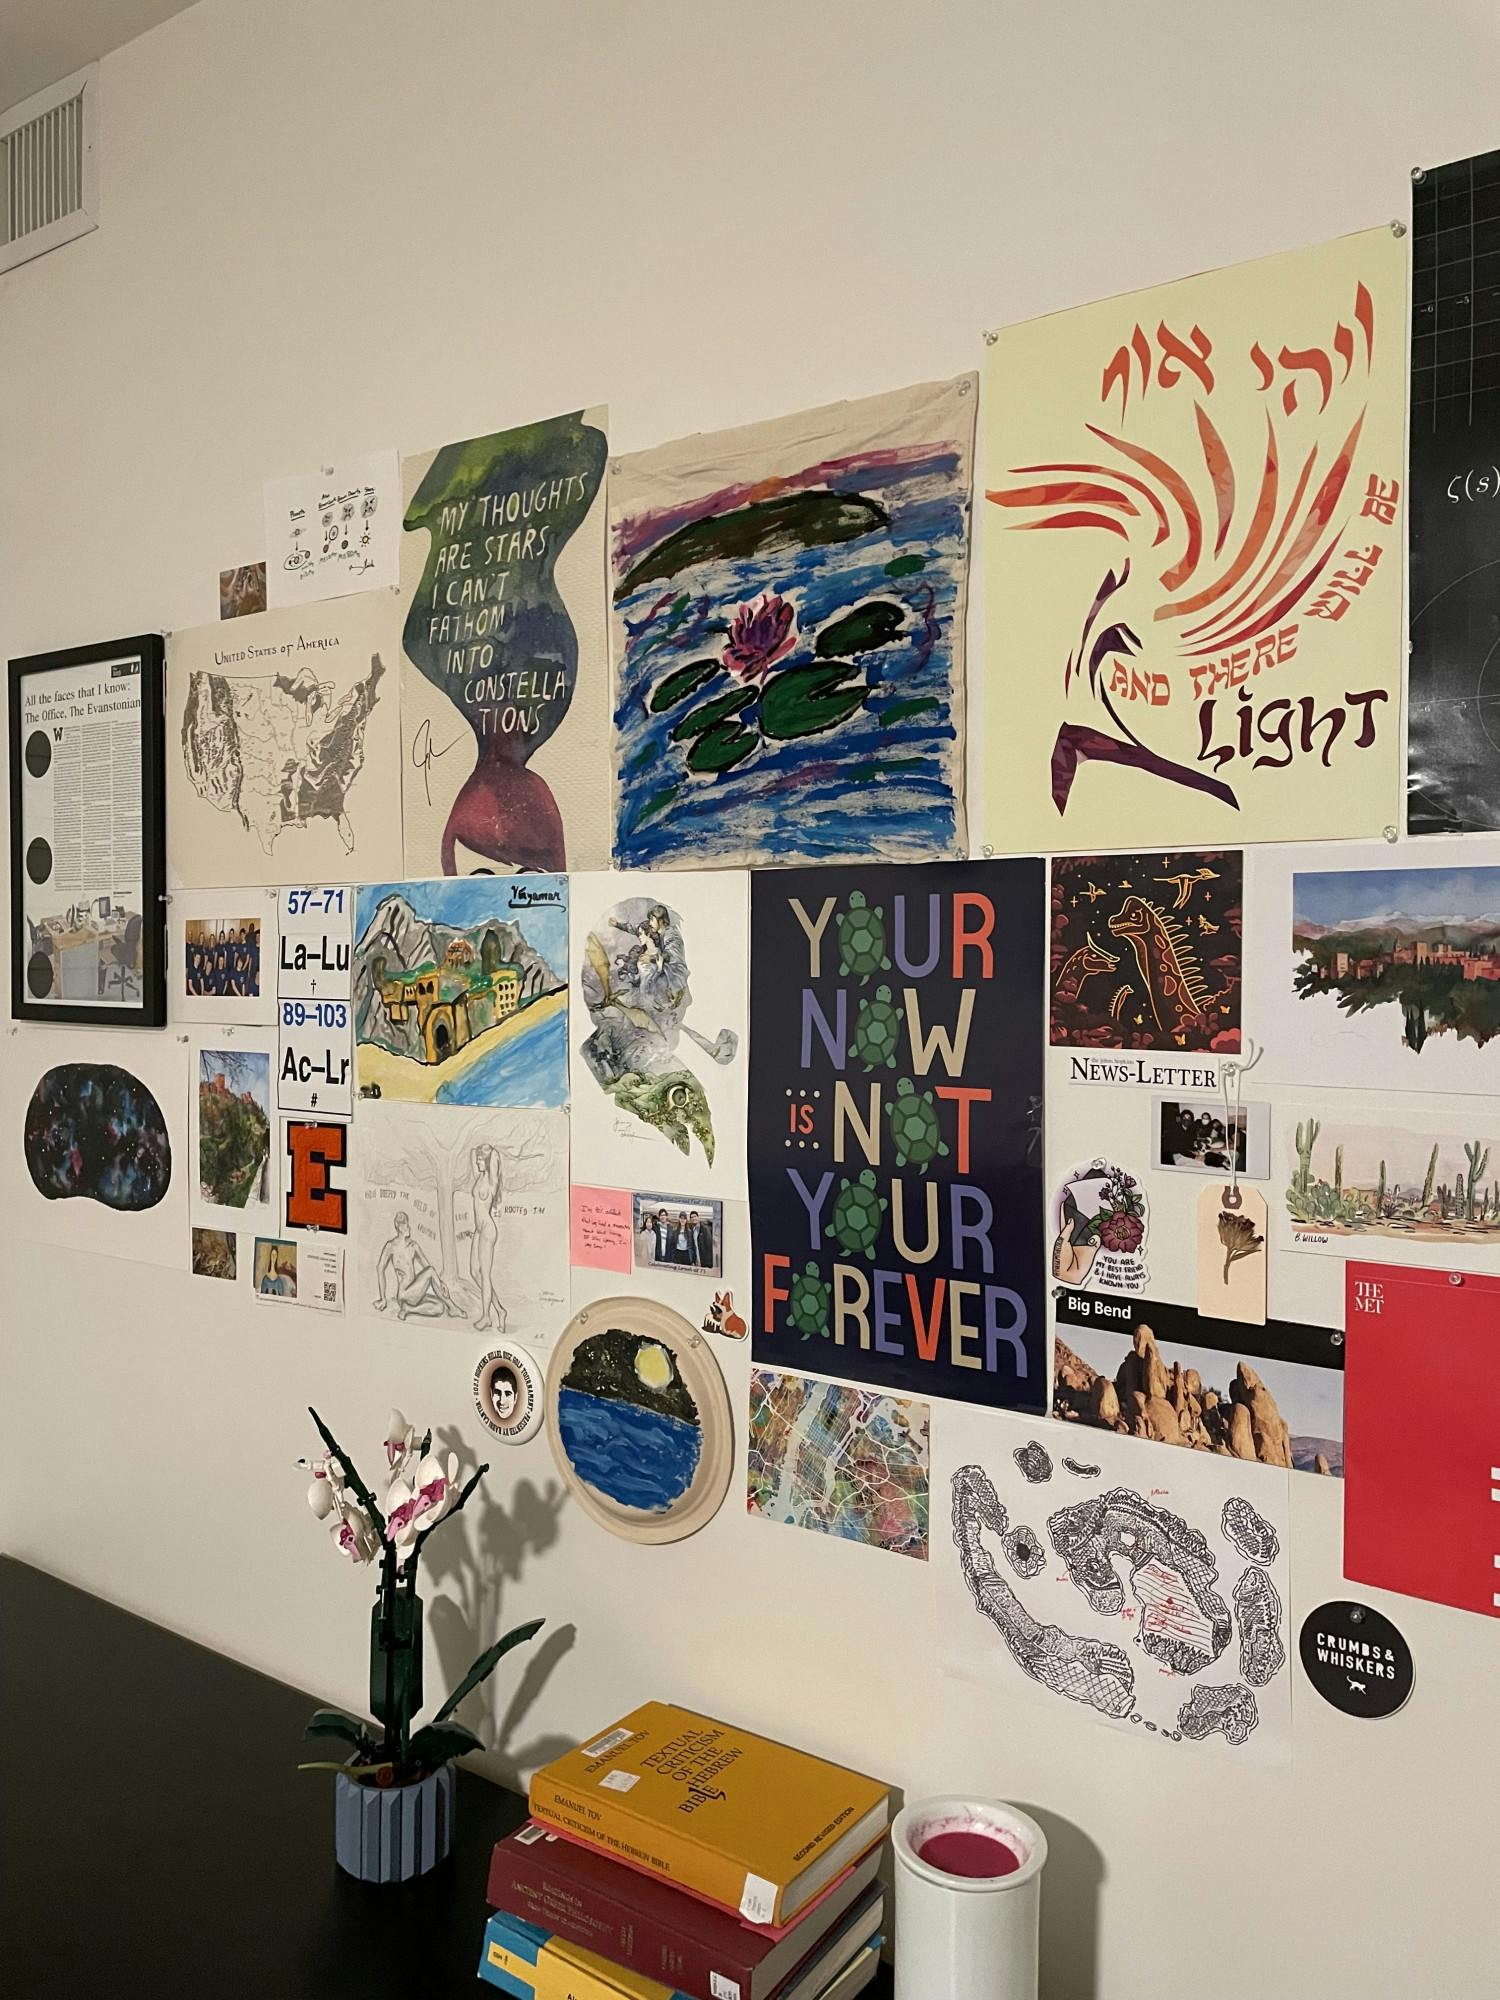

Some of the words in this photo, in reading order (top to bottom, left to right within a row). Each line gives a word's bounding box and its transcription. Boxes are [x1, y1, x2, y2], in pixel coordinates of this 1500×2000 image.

[1250, 280, 1375, 416] ויהי
[1101, 318, 1215, 427] אור
[440, 502, 469, 536] MY
[479, 472, 588, 527] THOUGHTS
[434, 542, 472, 578] ARE
[484, 525, 550, 565] STARS
[433, 582, 439, 609] I
[446, 571, 511, 606] CAN'T
[1109, 658, 1171, 706] AND
[1189, 624, 1299, 700] THERE
[1303, 544, 1384, 622] WILL
[1361, 473, 1400, 525] BE
[428, 605, 505, 645] FATHOM
[446, 644, 494, 675] INTO
[24, 695, 36, 706] All
[38, 693, 52, 705] the
[54, 690, 75, 703] faces
[78, 687, 95, 699] that
[464, 671, 566, 704] CONSTELLA
[25, 712, 40, 724] The
[41, 708, 67, 721] Office,
[69, 705, 85, 718] The
[87, 698, 141, 715] Evanstonian
[478, 704, 545, 735] TIONS
[53, 727, 63, 742] W
[787, 889, 997, 984] YUR
[800, 985, 976, 1077] NW
[790, 1103, 815, 1135] IS
[833, 1078, 992, 1175] NT
[286, 1121, 347, 1234] E
[504, 1205, 528, 1216] ROOTED
[785, 1168, 995, 1274] YUR
[1302, 1234, 1329, 1243] WILLOW
[1095, 1261, 1105, 1269] MY
[1107, 1265, 1122, 1273] BEST
[1124, 1264, 1144, 1273] FRIEND
[1103, 1255, 1118, 1264] YOU
[1120, 1258, 1135, 1266] ARE
[1106, 1272, 1122, 1280] HAVE
[1124, 1272, 1146, 1281] ALWAYS
[1098, 1277, 1123, 1288] KNOWN
[1354, 1281, 1384, 1299] THE
[763, 1253, 1029, 1379] FREVER
[1068, 1296, 1091, 1316] Big
[1094, 1301, 1132, 1319] Bend
[1354, 1296, 1385, 1314] MET
[520, 1367, 535, 1412] TOURNAMENT
[1316, 1632, 1381, 1660] CRUMBS
[1384, 1649, 1395, 1662] &
[1316, 1647, 1395, 1680] WHISKERS
[584, 1742, 632, 1773] EMANUEL
[630, 1730, 650, 1744] TOV
[640, 1729, 704, 1768] TEXTUAL
[656, 1729, 726, 1775] CRITICISM
[671, 1767, 694, 1781] OF
[691, 1746, 724, 1768] THE
[686, 1747, 744, 1789] HEBREW
[533, 1803, 562, 1823] TEXTUAL
[554, 1795, 587, 1817] EMANUEL
